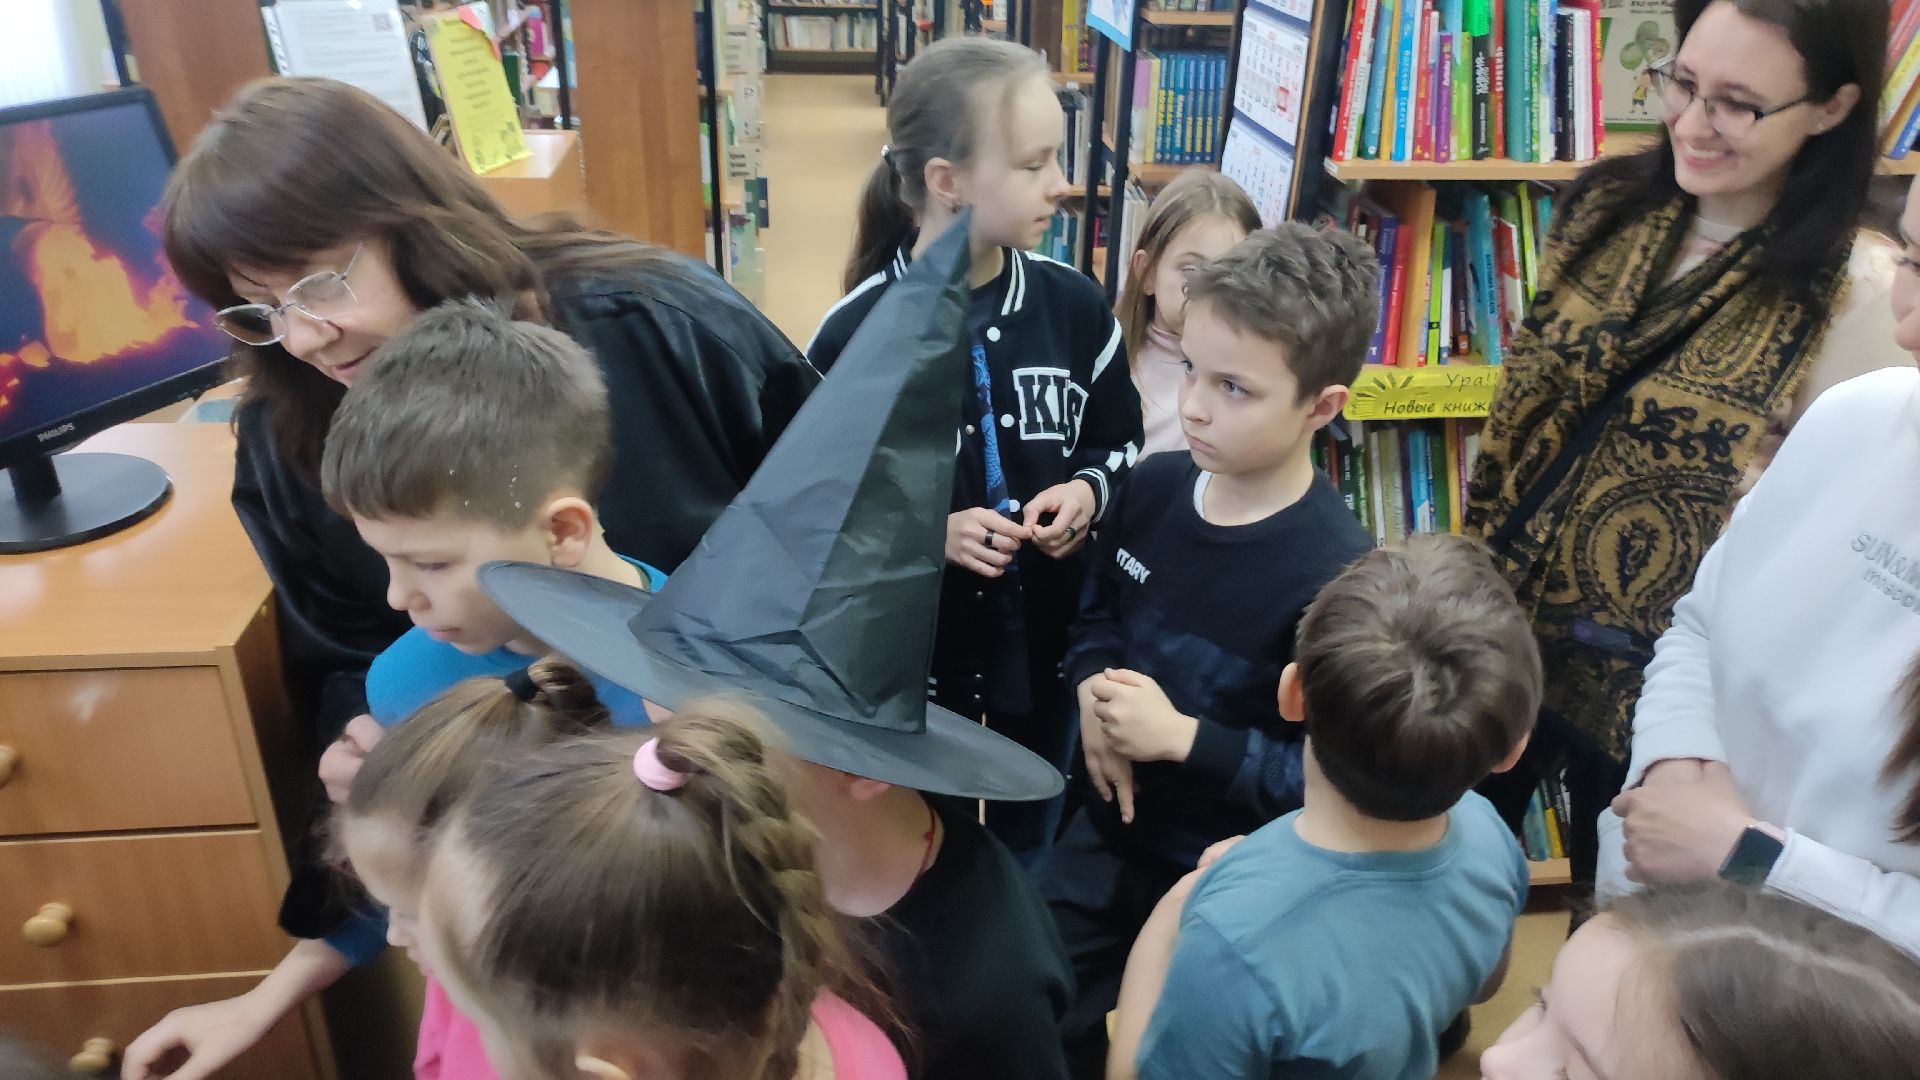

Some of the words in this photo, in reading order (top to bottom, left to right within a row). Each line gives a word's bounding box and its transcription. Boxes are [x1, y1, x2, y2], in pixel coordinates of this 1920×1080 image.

[1384, 400, 1435, 415] Новые
[1442, 401, 1492, 413] книж
[37, 422, 76, 442] PHILIPS
